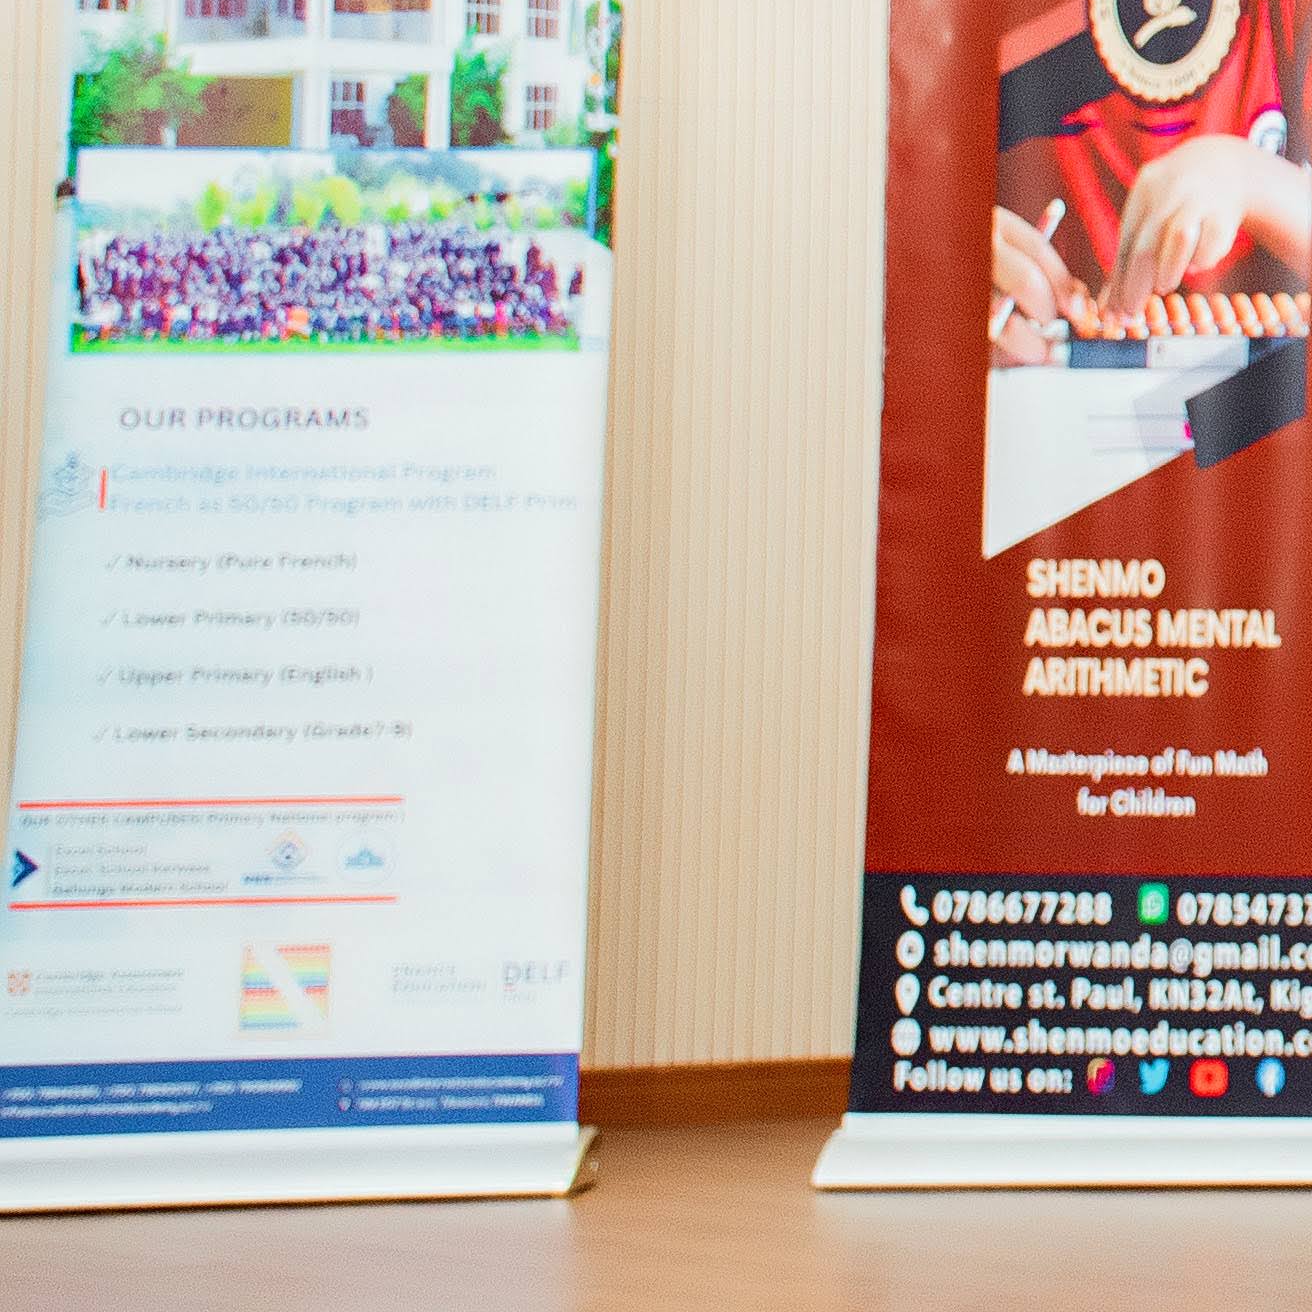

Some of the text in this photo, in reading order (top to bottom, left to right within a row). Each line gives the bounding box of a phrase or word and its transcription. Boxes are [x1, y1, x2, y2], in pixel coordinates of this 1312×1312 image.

[119, 406, 371, 431] OUR PROGRAMS
[110, 461, 497, 486] Cambridge International Program
[109, 492, 191, 514] French
[306, 492, 403, 516] Program
[409, 492, 456, 513] with
[125, 552, 358, 574] Nursery (Pure French)
[1027, 558, 1166, 599] SHENMO
[121, 610, 186, 627] Lower
[193, 609, 276, 630] Primary
[1024, 608, 1282, 649] ABACUS MENTAL
[118, 668, 183, 687] Upper
[190, 667, 272, 687] Primary
[1022, 656, 1209, 698] ARITHMETIC
[114, 725, 178, 742] Lower
[186, 725, 296, 746] Secondary
[1007, 748, 1269, 781] A Masterpiece of Fun Math
[1077, 787, 1196, 817] for Children
[932, 890, 1112, 925] 0786677288
[927, 975, 1023, 1009] Centre
[1027, 980, 1065, 1010] st.
[1070, 977, 1142, 1014] Paul,
[894, 1060, 1072, 1094] Follow us on:
